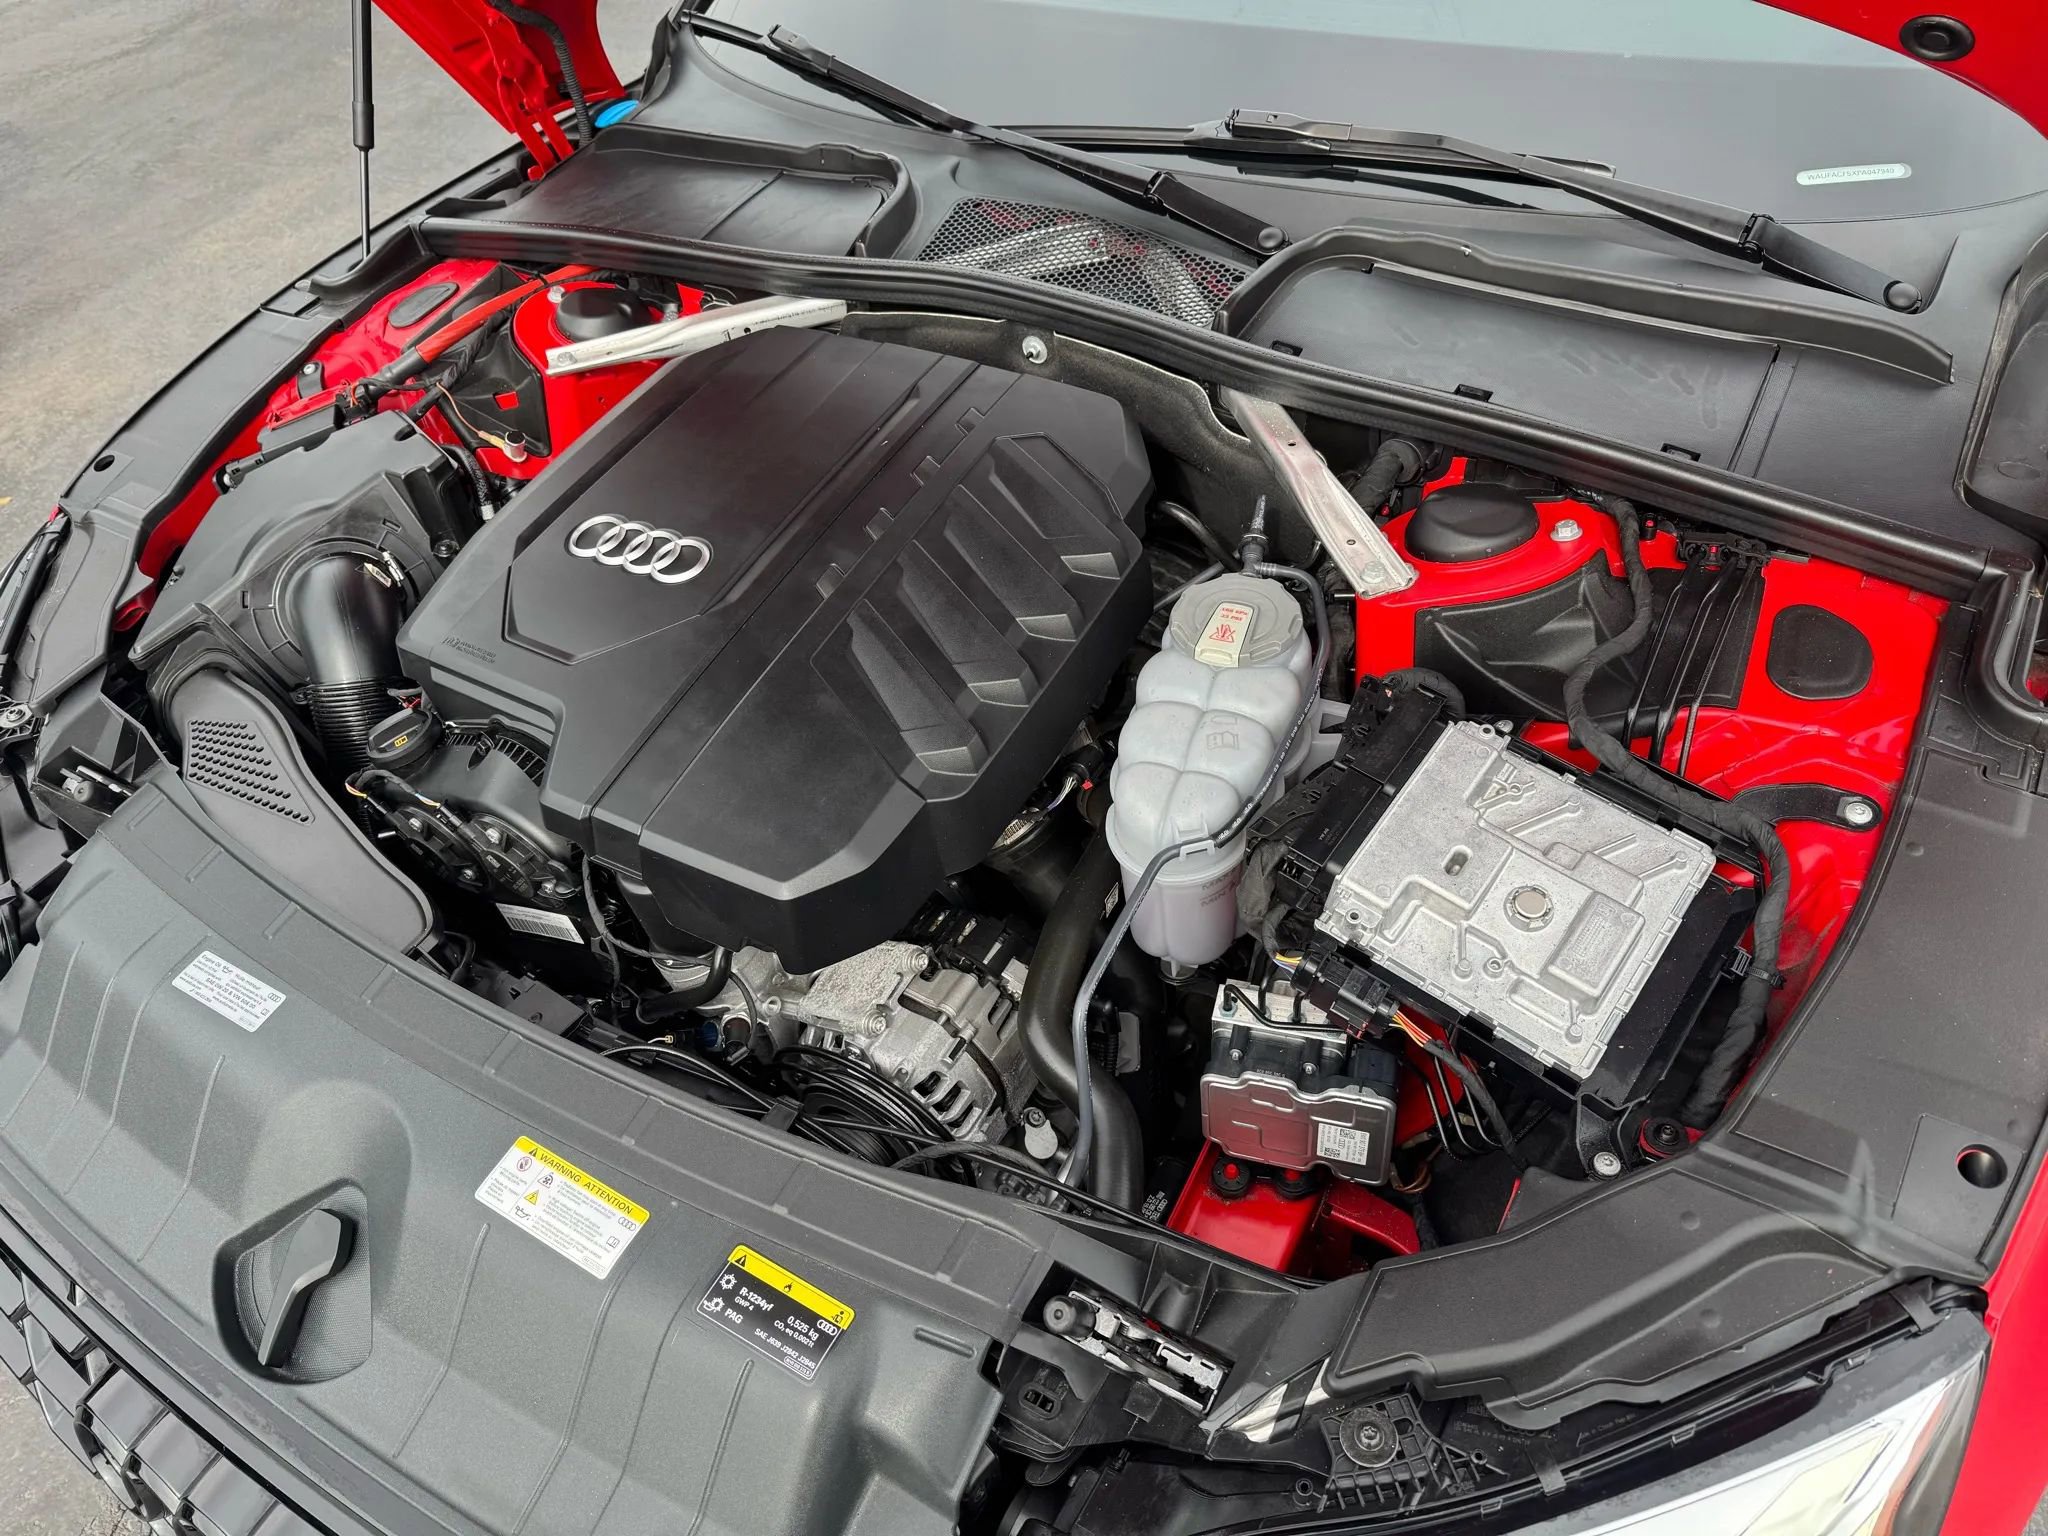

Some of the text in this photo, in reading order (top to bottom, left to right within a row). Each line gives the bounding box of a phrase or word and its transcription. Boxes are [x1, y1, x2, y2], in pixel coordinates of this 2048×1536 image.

[540, 1153, 582, 1183] WARNING
[584, 1181, 633, 1215] ATTENTION
[734, 1296, 749, 1309] GWP
[739, 1287, 774, 1312] R-1234yf
[724, 1308, 744, 1324] PAG
[787, 1315, 819, 1341] 0,525 kg
[784, 1327, 794, 1336] eq
[753, 1327, 768, 1340] SAE
[766, 1336, 781, 1348] J639
[797, 1355, 816, 1369] J2845
